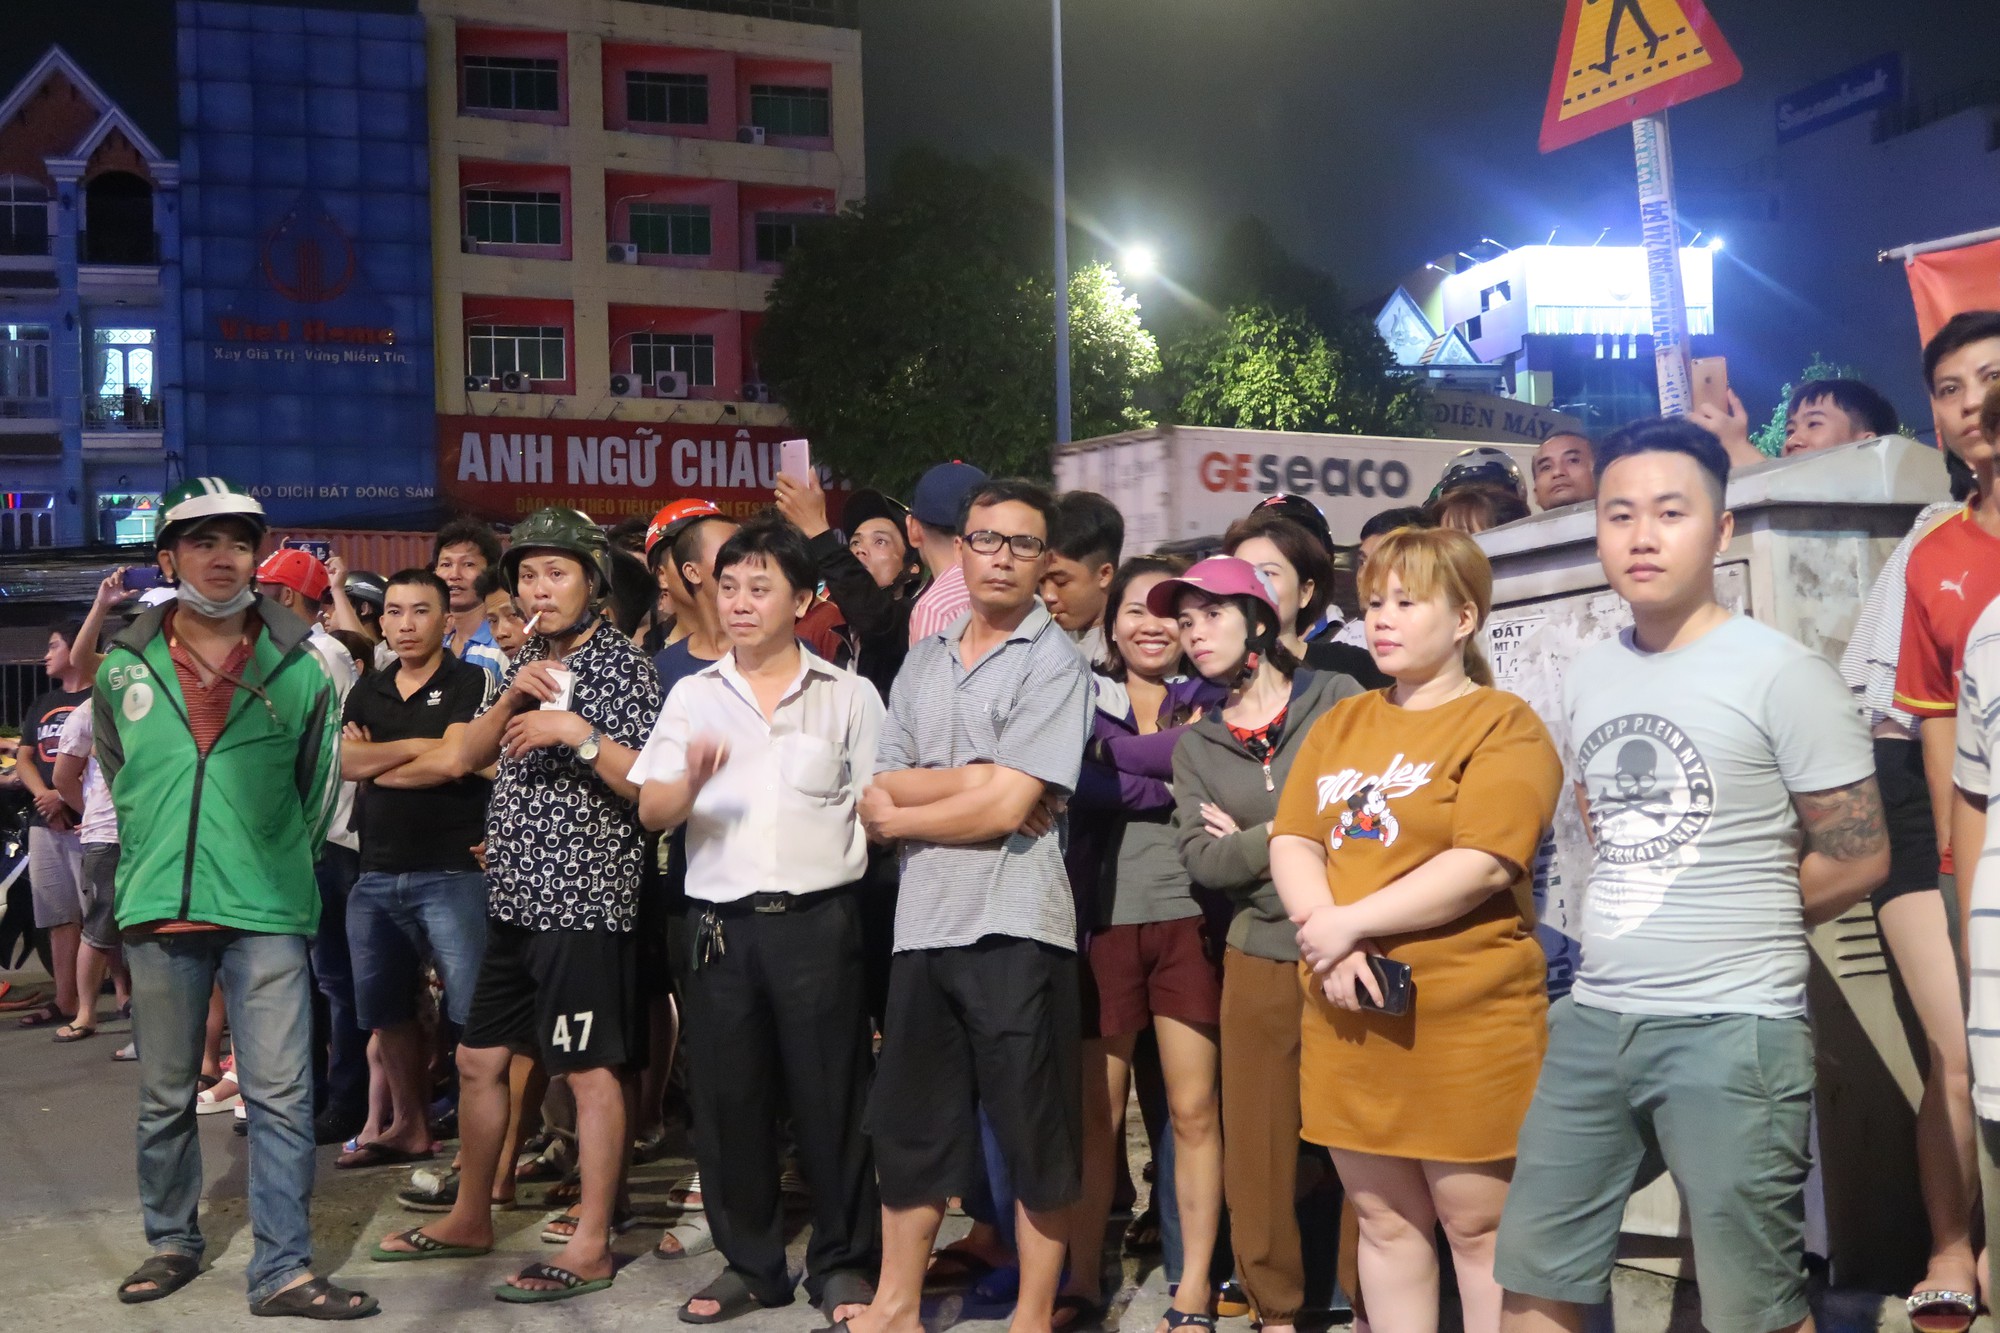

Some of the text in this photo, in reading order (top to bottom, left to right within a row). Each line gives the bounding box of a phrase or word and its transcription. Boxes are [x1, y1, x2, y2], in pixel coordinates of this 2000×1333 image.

[1434, 402, 1555, 440] ĐIỆN MÁY
[457, 431, 553, 483] ANH
[567, 427, 662, 487] NGỮ
[320, 483, 349, 498] BẤT
[356, 483, 399, 501] ĐỘNG
[580, 498, 615, 515] THEO
[1492, 623, 1523, 639] ĐẤT
[1633, 717, 1684, 750] PLEIN
[1679, 747, 1709, 790] NYC
[1316, 753, 1437, 815] Mickey
[552, 1010, 594, 1053] 47
